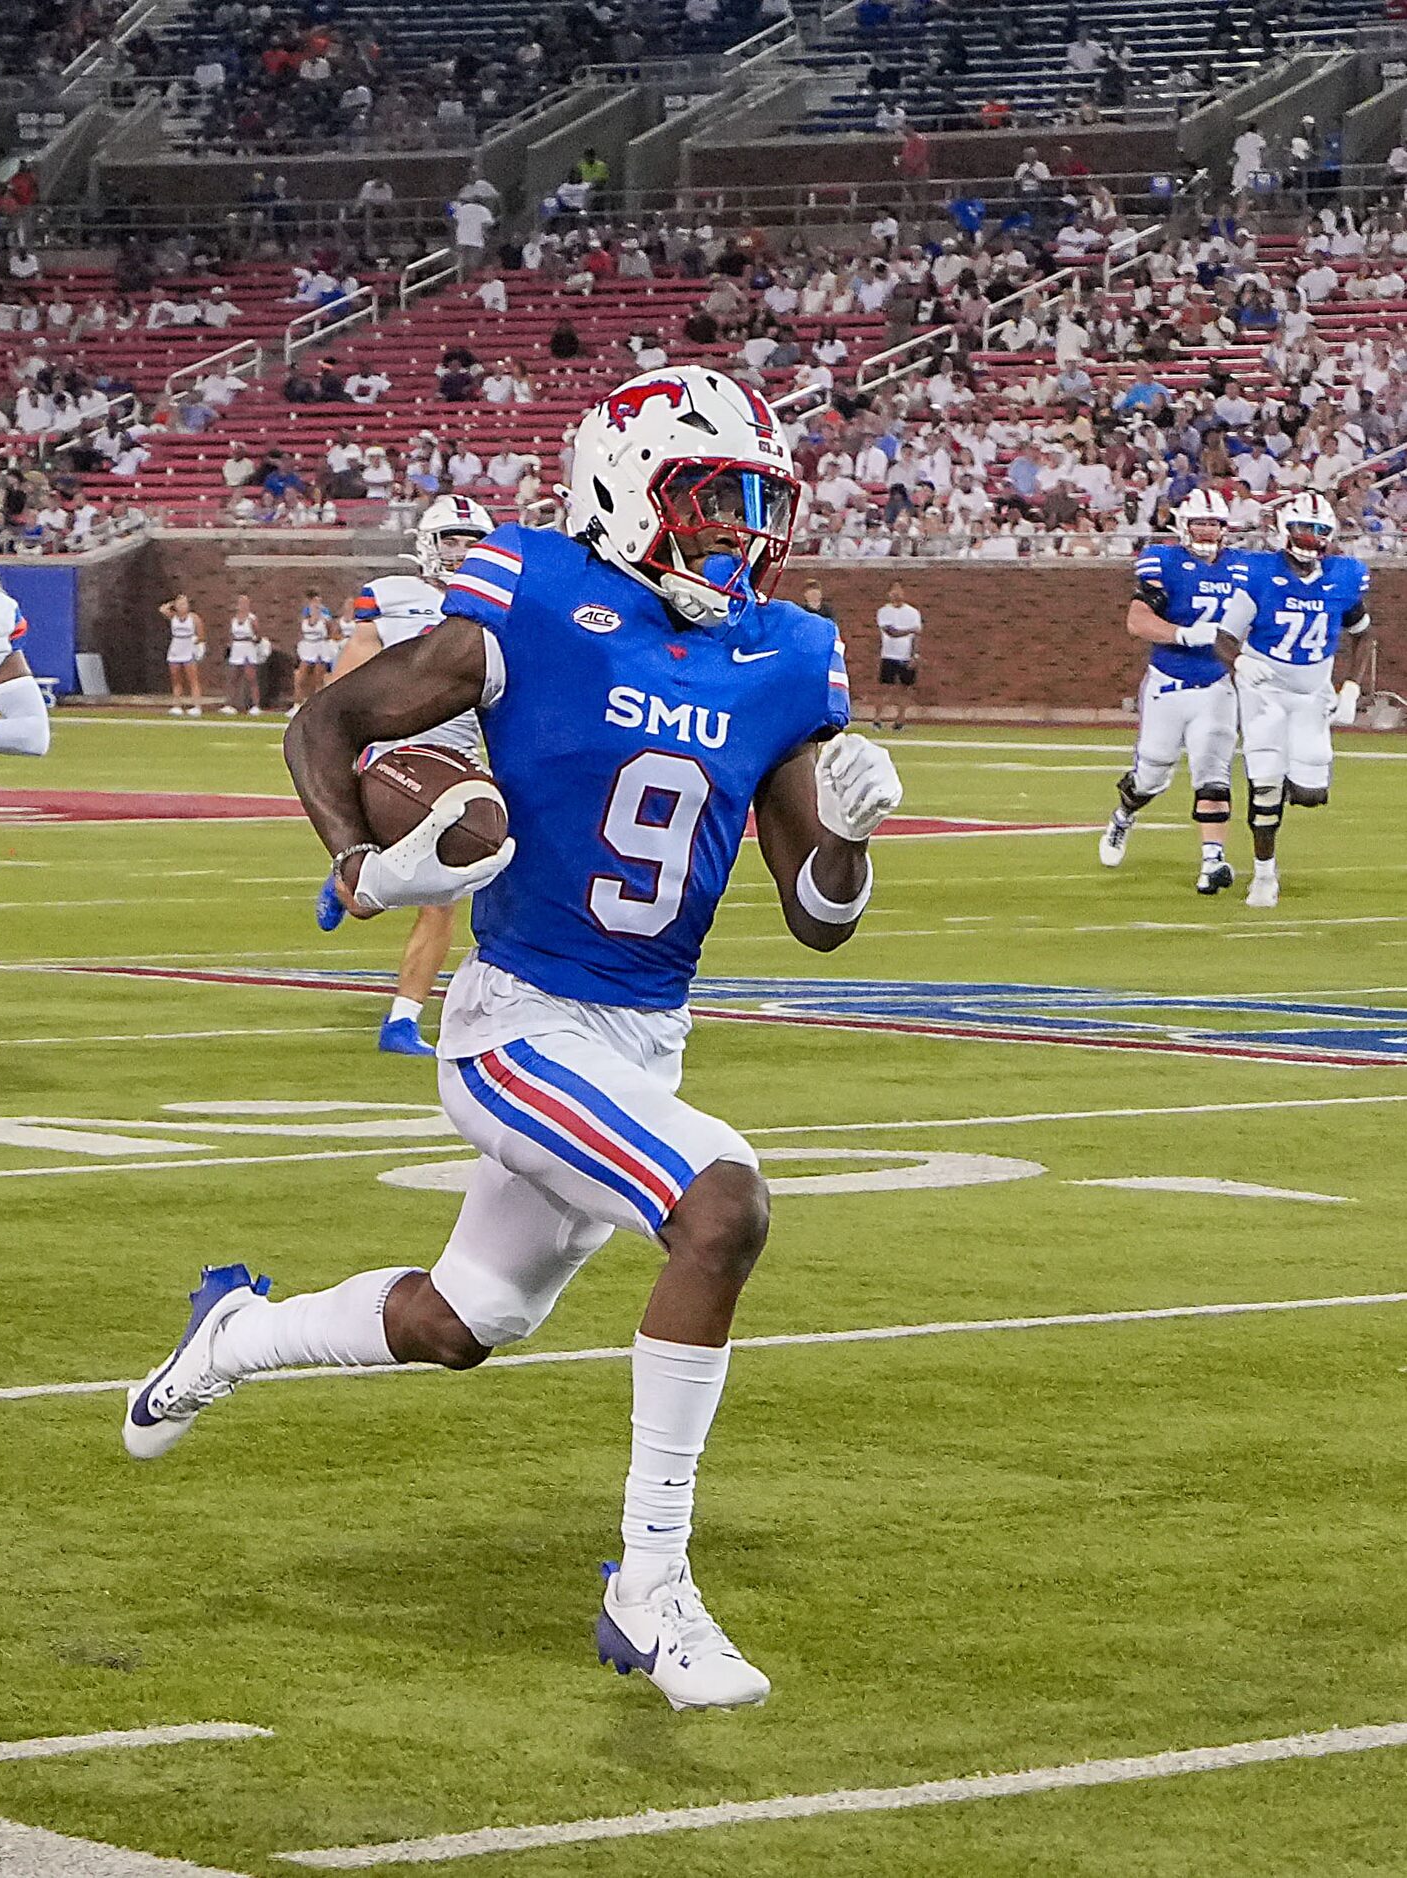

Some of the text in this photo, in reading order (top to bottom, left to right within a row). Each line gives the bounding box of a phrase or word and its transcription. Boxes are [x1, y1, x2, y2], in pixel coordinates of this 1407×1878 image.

[1198, 581, 1232, 595] SMU
[1285, 597, 1324, 612] SMU
[579, 611, 616, 625] ACC
[1269, 611, 1329, 662] 74
[605, 686, 731, 749] SMU
[585, 748, 712, 938] 9
